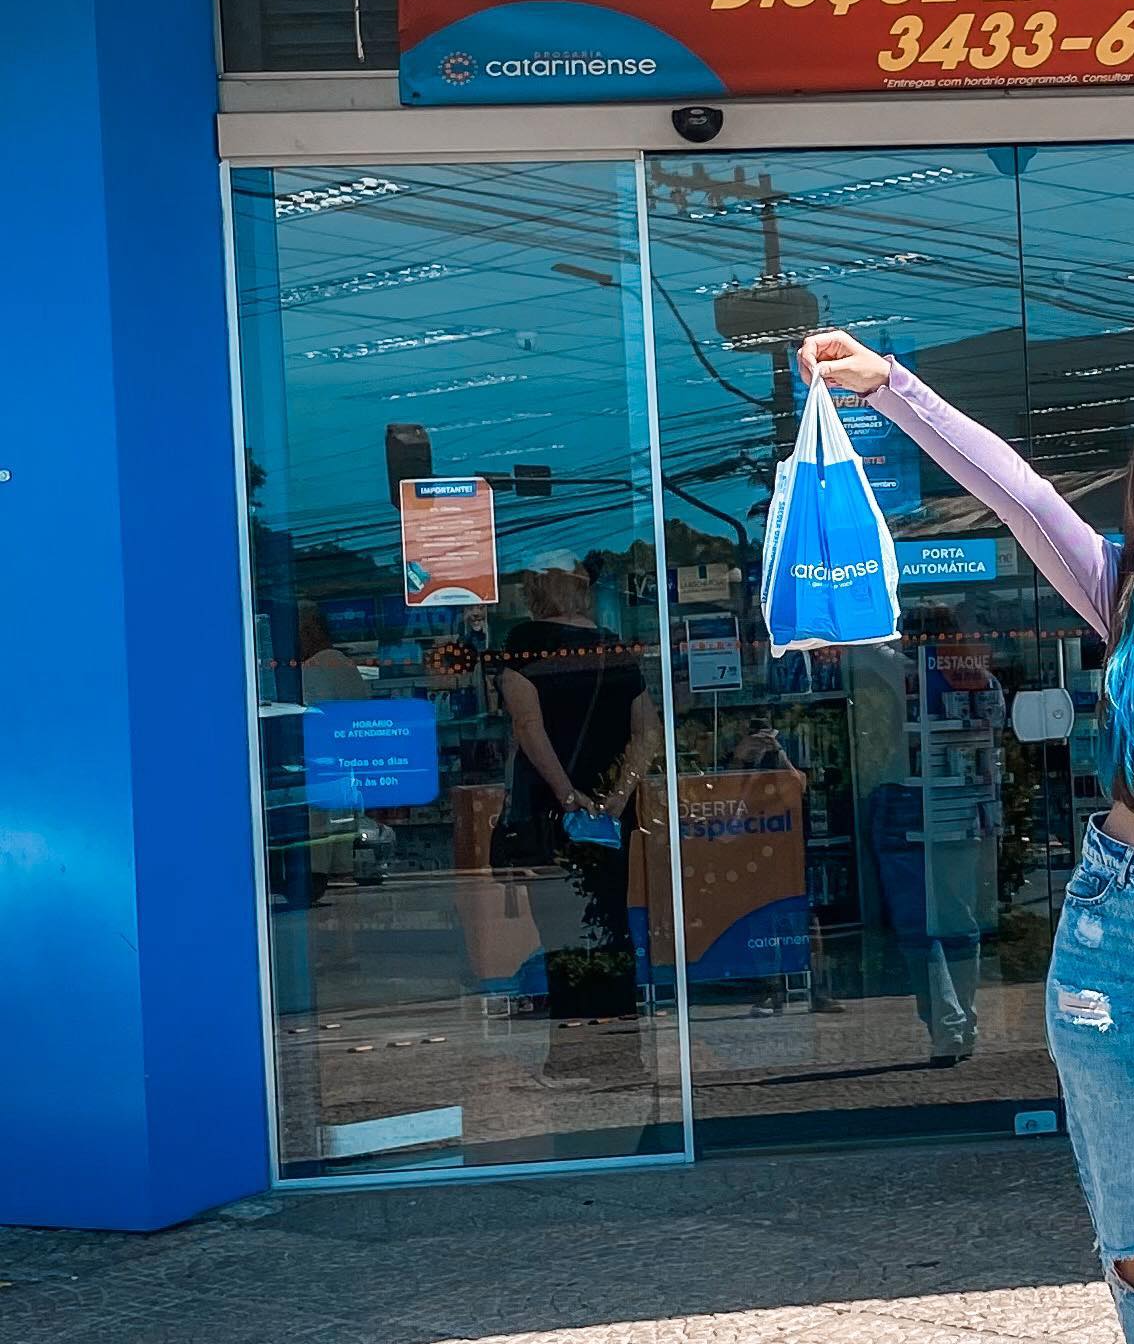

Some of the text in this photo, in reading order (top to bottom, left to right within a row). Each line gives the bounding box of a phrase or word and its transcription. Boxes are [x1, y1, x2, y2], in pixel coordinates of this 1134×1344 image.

[485, 58, 657, 78] catarinense
[938, 78, 963, 88] com
[964, 75, 1005, 87] horário
[1082, 71, 1133, 84] Consultar
[922, 547, 965, 560] PORTA
[902, 560, 987, 575] AUTOMÁTICA
[928, 655, 992, 671] DESTAQUE
[352, 718, 394, 729] HORÁRIO
[334, 727, 410, 739] DE ATENDIMENTO
[338, 757, 369, 768] Todos
[387, 756, 409, 765] dias
[678, 799, 749, 819] OFERTA
[680, 809, 792, 841] especial
